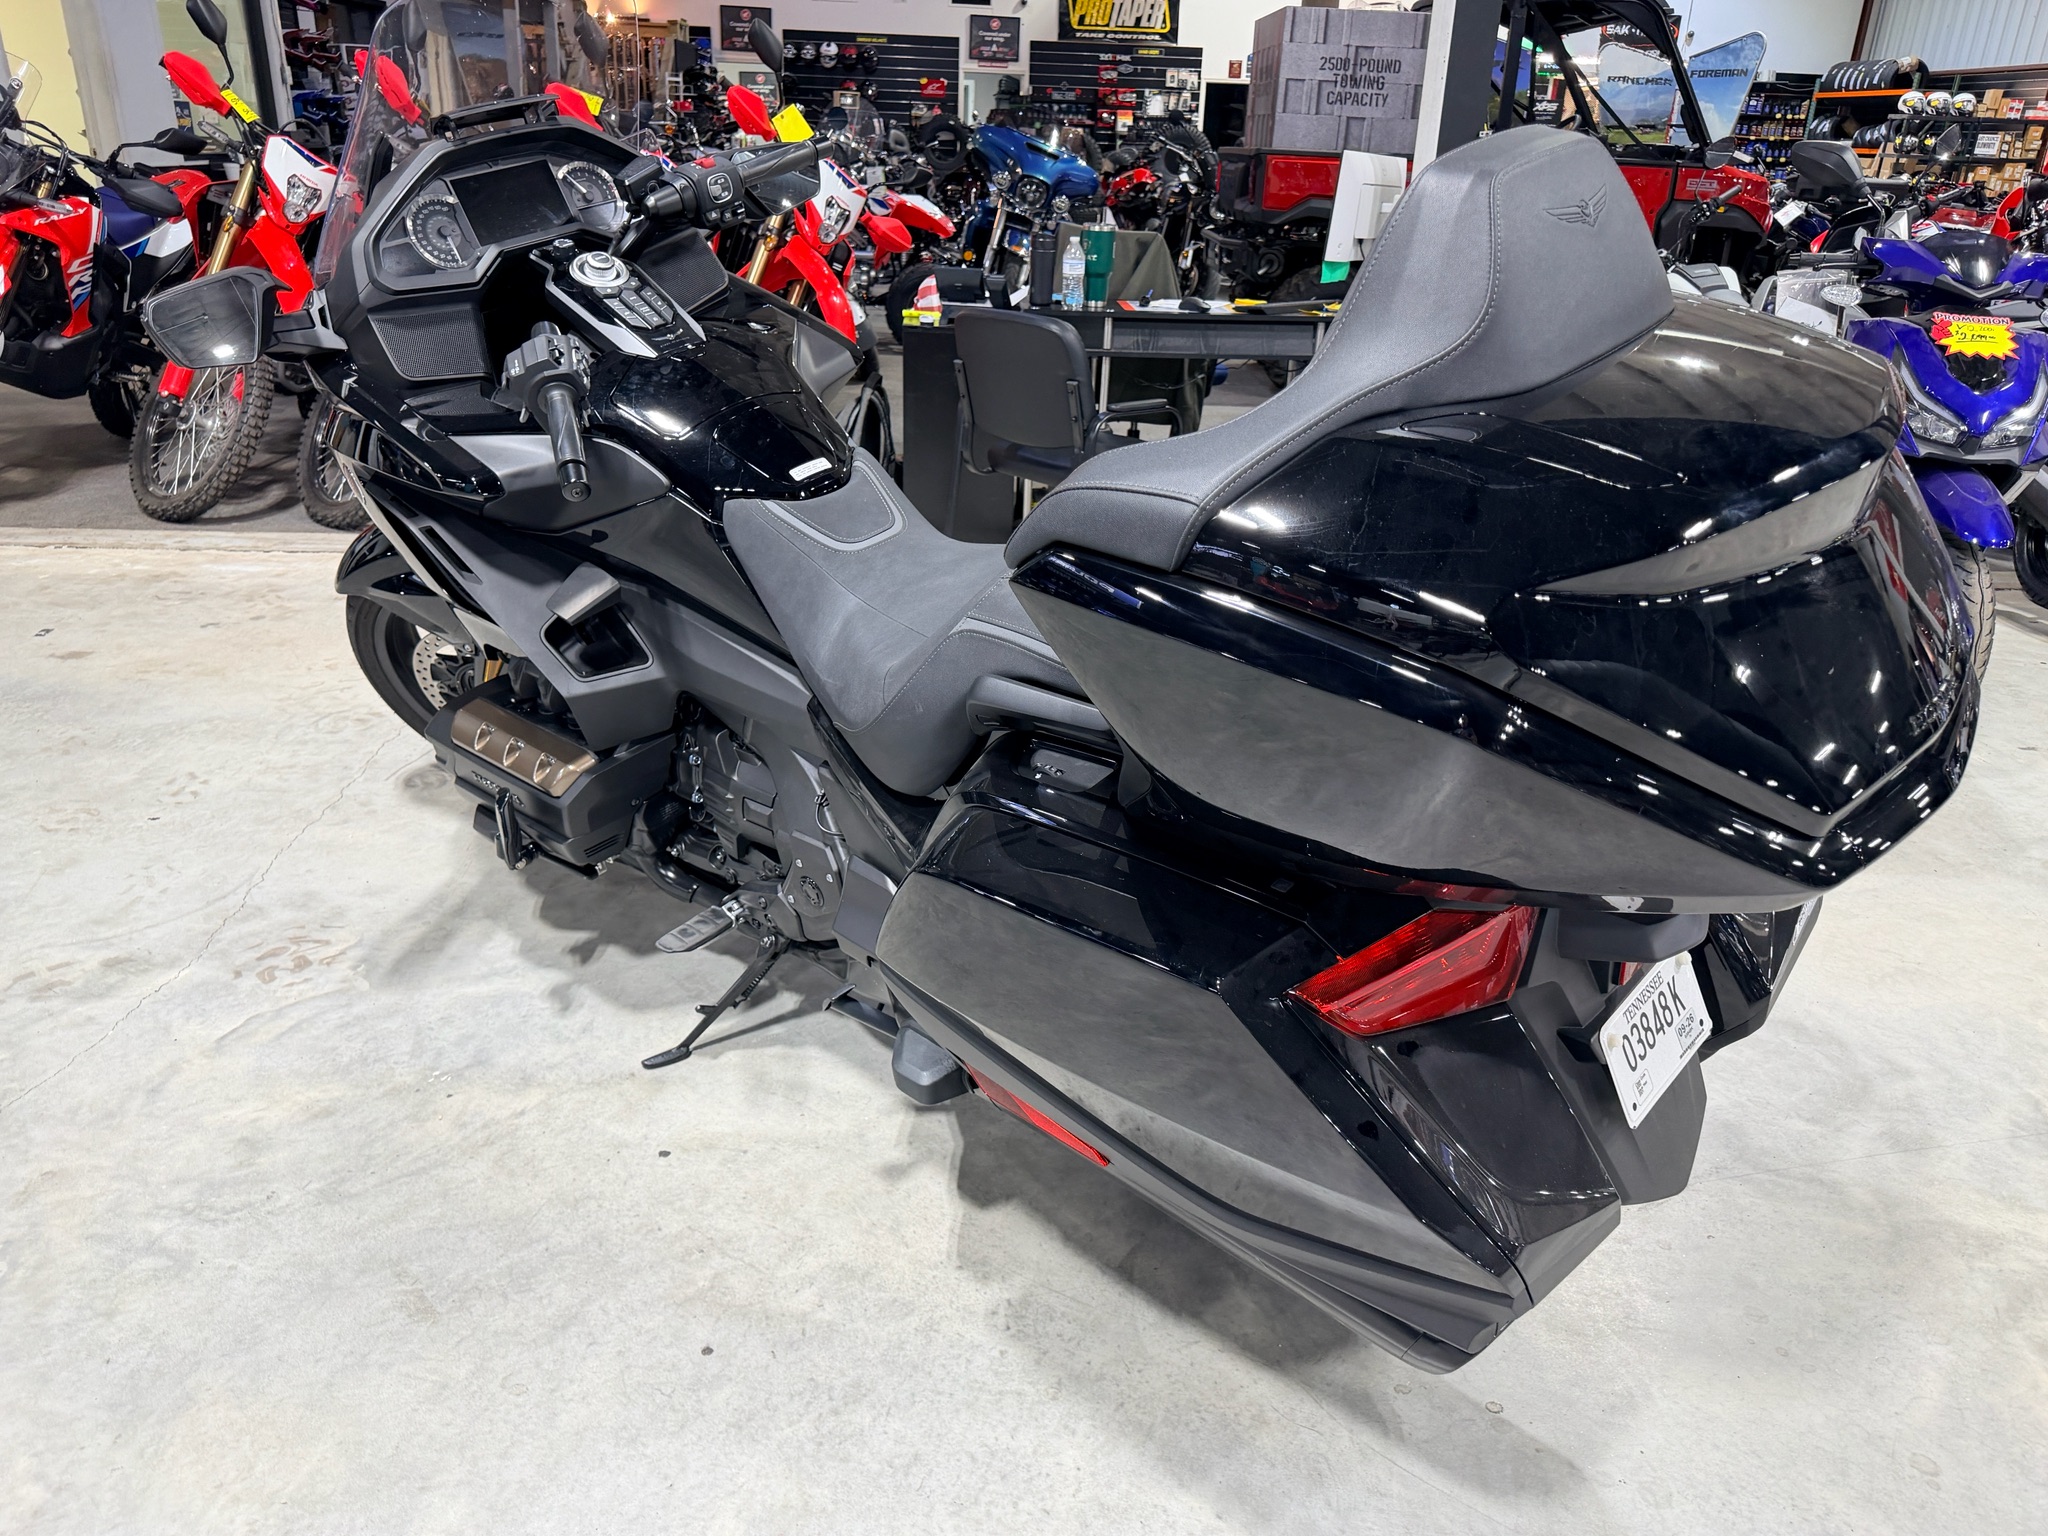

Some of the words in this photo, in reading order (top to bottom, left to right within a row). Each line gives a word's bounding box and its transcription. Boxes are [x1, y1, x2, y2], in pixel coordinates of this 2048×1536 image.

[1689, 68, 1748, 78] FOREMAN
[1333, 73, 1386, 91] TOWING
[1607, 75, 1674, 87] RANCHER
[1326, 91, 1389, 107] CAPACITY
[1935, 312, 2011, 325] PROMOTION
[1622, 970, 1664, 1025] TENNESSEE
